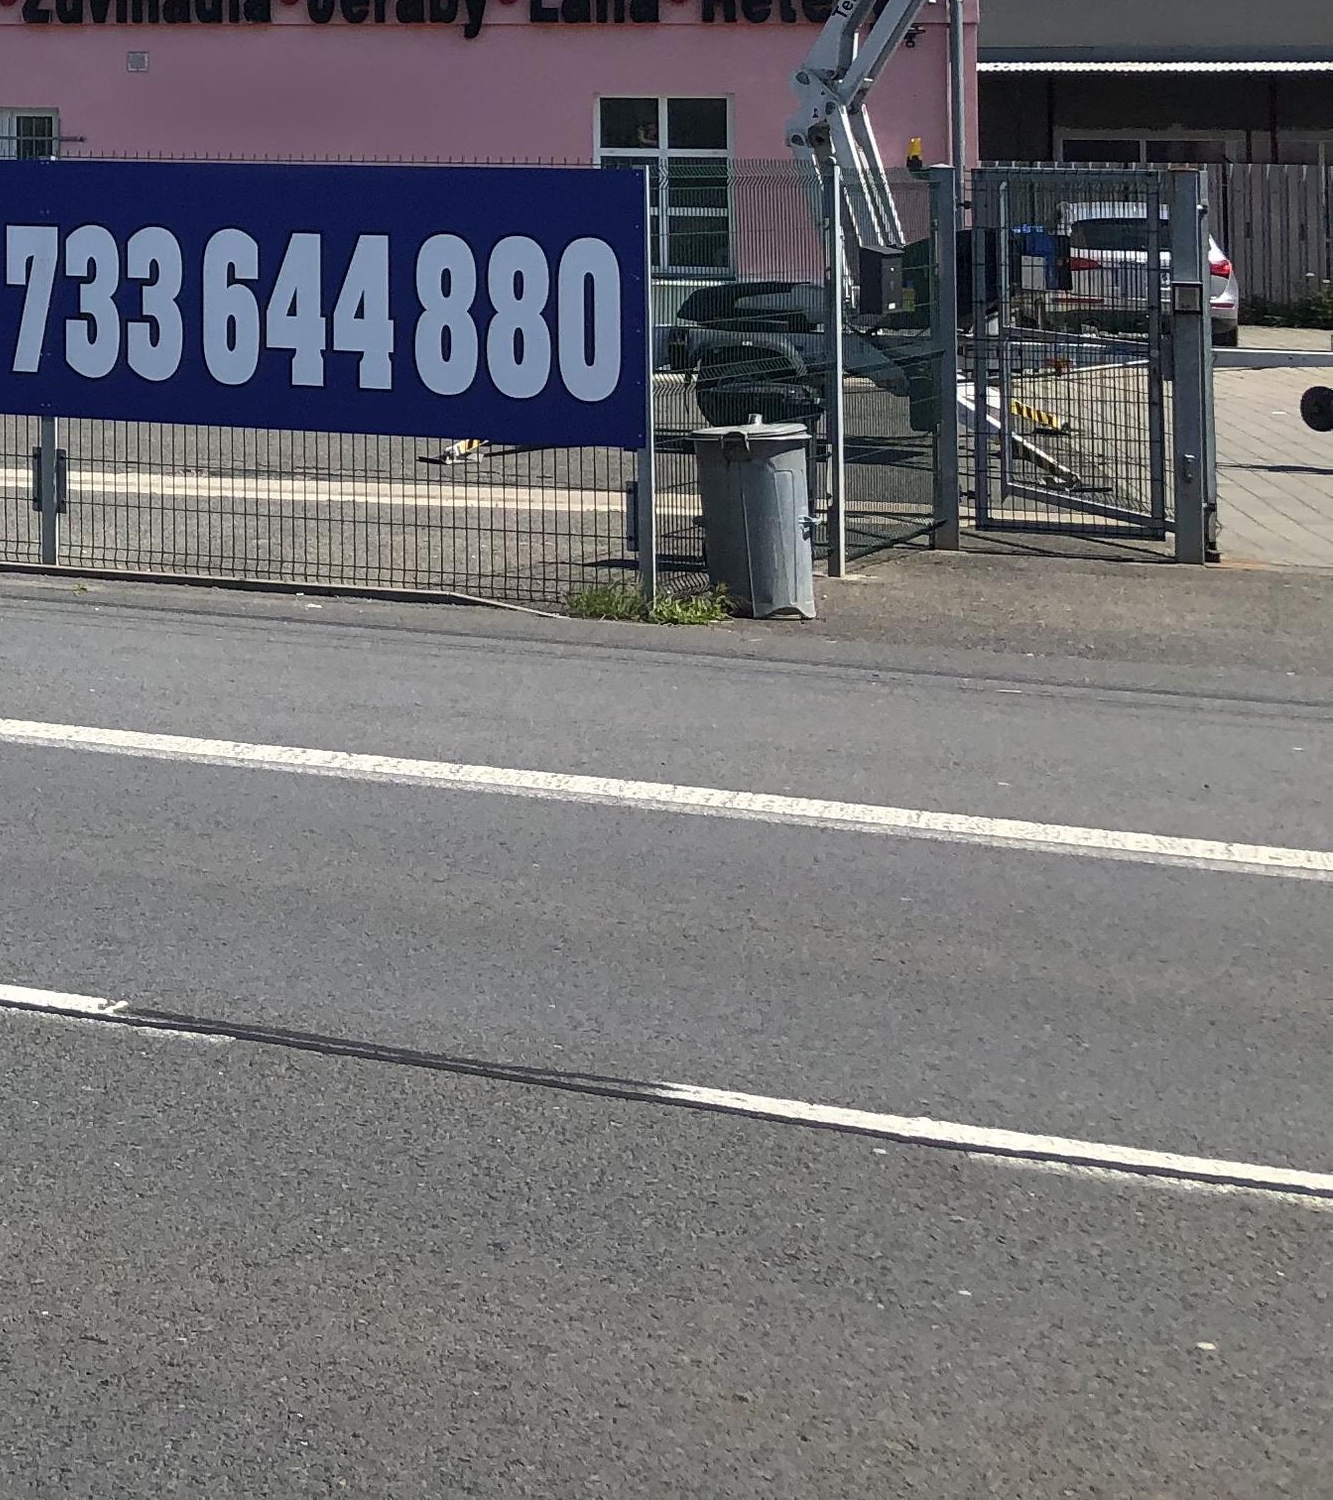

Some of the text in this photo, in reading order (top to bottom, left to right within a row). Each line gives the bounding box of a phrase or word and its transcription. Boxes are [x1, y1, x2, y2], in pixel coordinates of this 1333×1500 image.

[6, 224, 184, 381] 733
[202, 227, 395, 391] 644
[415, 233, 622, 402] 880
